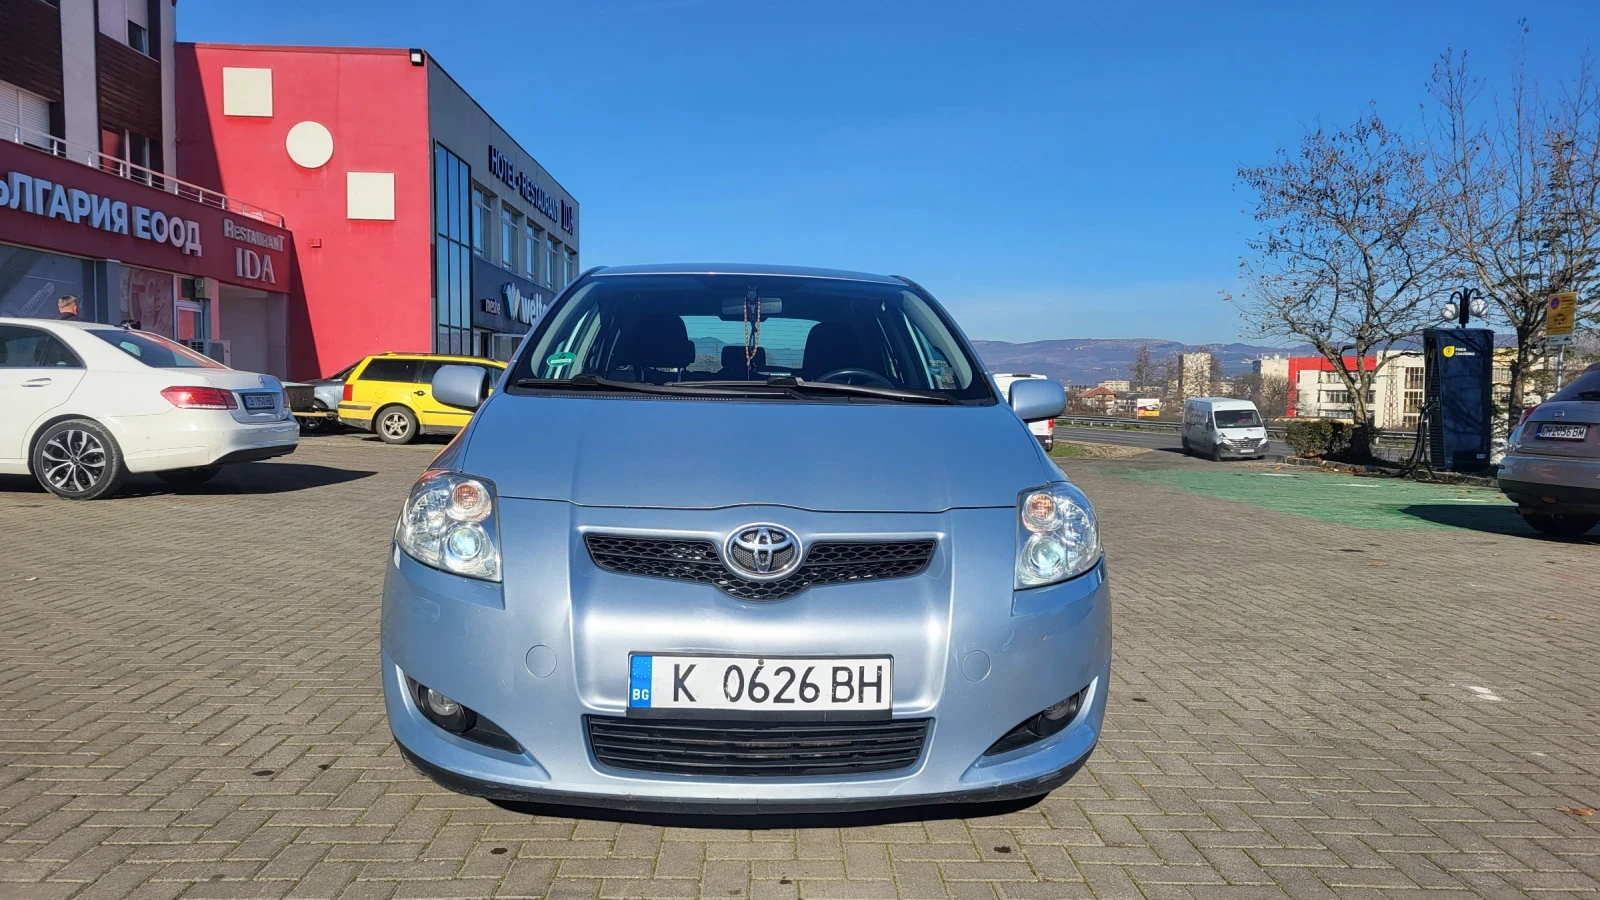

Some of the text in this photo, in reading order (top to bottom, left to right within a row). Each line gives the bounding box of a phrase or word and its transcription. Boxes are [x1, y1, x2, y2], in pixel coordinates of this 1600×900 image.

[489, 145, 516, 190] HOTEL
[520, 172, 559, 223] RESTAURANT
[132, 205, 202, 257] ЕООД
[235, 247, 276, 284] IDA
[632, 689, 650, 701] BG
[673, 663, 697, 702] K
